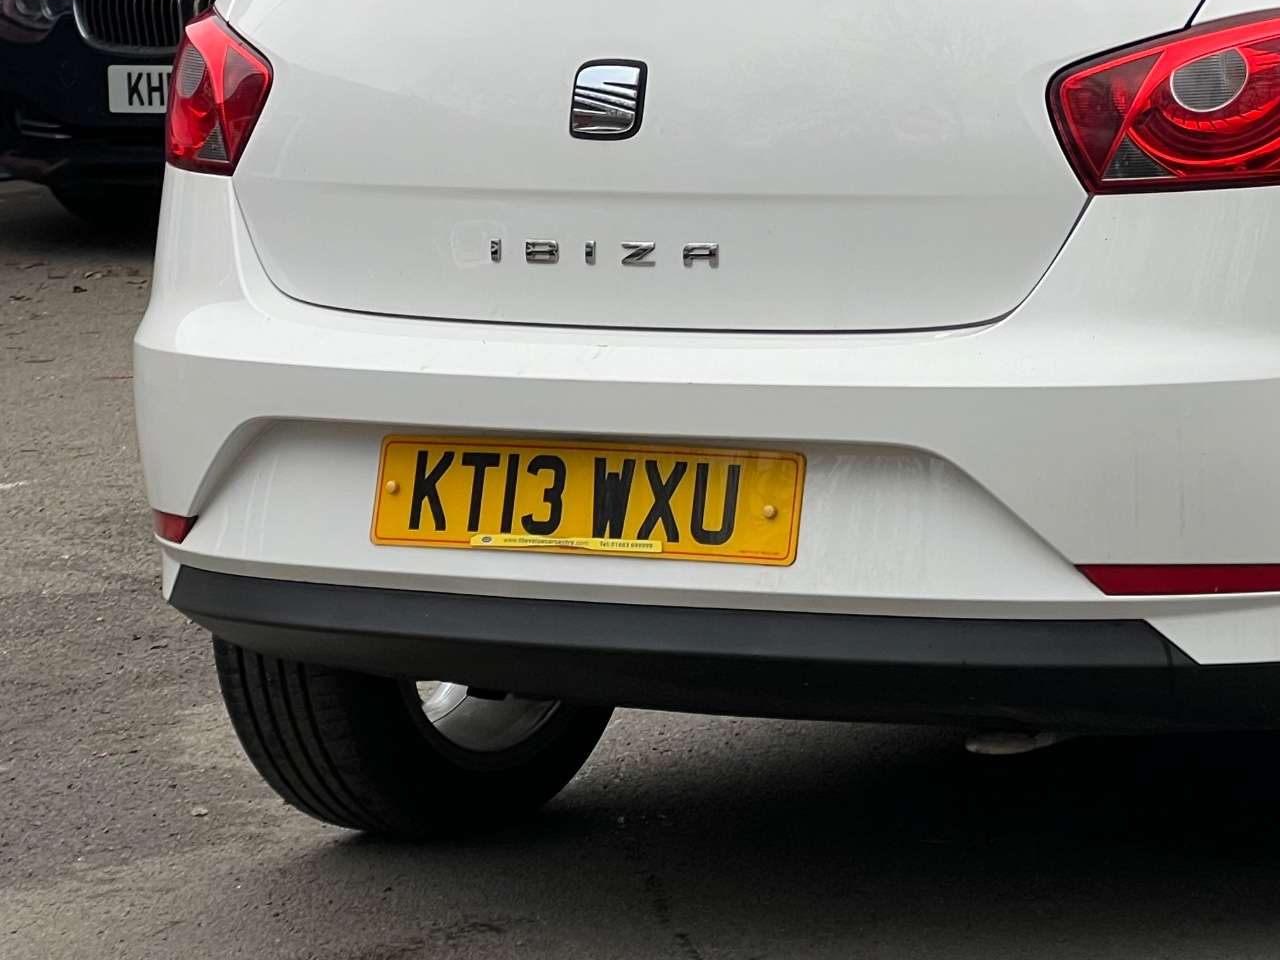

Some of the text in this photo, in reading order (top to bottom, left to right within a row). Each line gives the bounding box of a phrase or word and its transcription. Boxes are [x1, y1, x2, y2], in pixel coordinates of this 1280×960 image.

[127, 72, 172, 107] KH
[490, 239, 719, 268] IBIZA
[408, 450, 741, 546] KT13 WXU
